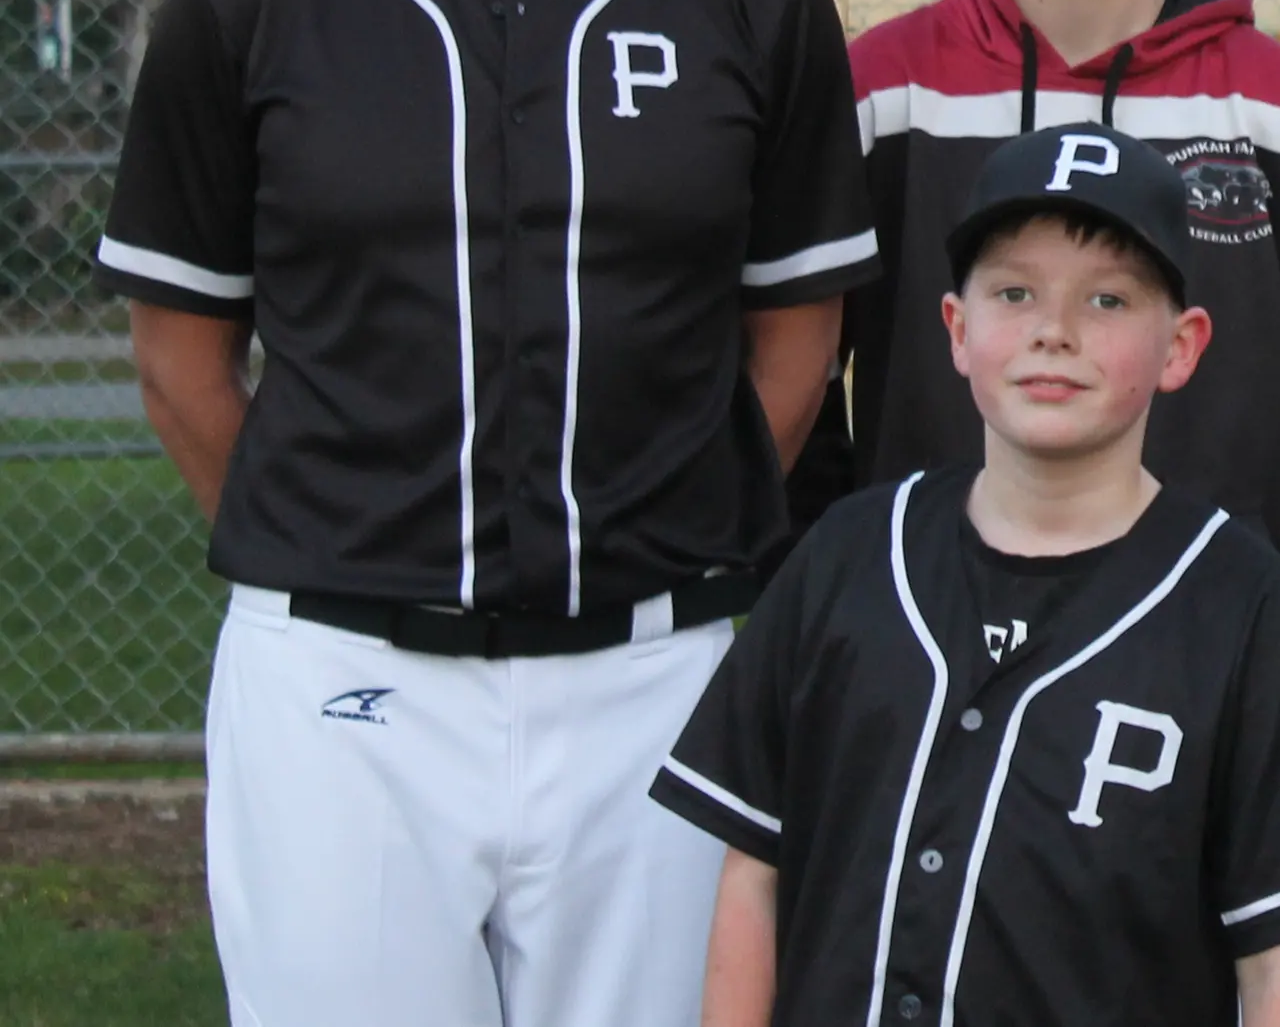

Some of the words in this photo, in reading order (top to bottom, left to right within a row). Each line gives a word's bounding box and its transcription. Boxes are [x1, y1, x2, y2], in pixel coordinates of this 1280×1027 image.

[606, 31, 679, 118] P
[1045, 134, 1120, 191] P
[1166, 141, 1231, 166] PUNKAH
[1067, 699, 1184, 828] P
